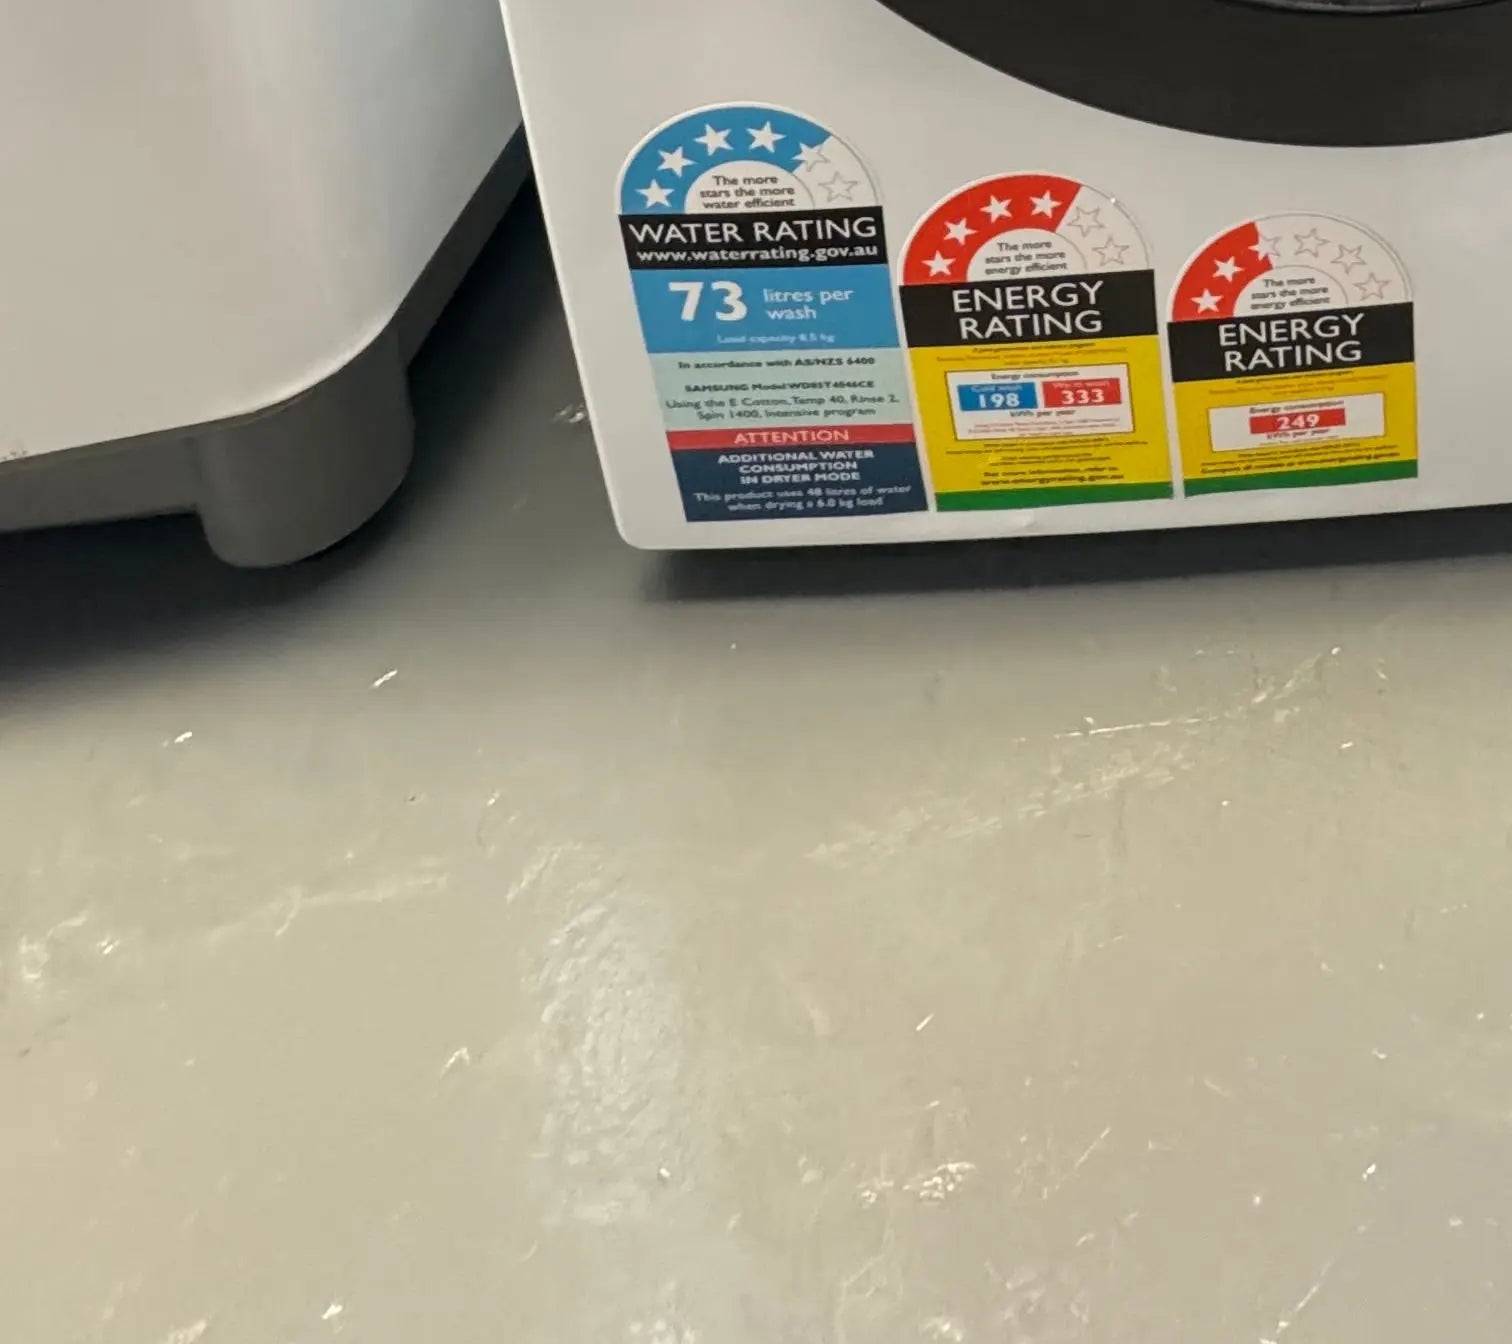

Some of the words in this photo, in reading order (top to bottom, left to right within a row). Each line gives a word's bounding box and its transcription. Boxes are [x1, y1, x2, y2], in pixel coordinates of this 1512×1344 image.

[713, 175, 740, 185] The
[743, 175, 778, 185] more
[700, 188, 730, 198] stars
[735, 187, 756, 197] the
[759, 186, 795, 196] more
[703, 199, 740, 210] water
[744, 197, 795, 209] efficient
[628, 223, 743, 244] WATER
[754, 216, 877, 242] RATING
[636, 244, 878, 262] www.waterrating.gov.au
[997, 242, 1020, 252] The
[1022, 241, 1052, 250] more
[985, 254, 1011, 264] stars
[1014, 253, 1033, 262] the
[1035, 251, 1066, 261] more
[985, 265, 1022, 276] energy
[1025, 261, 1068, 273] efficient
[1263, 278, 1285, 287] The
[1287, 276, 1315, 286] more
[763, 288, 813, 303] litres
[820, 289, 854, 305] per
[952, 280, 1104, 313] ENERGY
[1251, 290, 1277, 300] stars
[1279, 288, 1297, 297] the
[1299, 286, 1328, 295] more
[668, 280, 748, 322] 73
[1251, 301, 1287, 311] energy
[765, 306, 816, 320] wash
[959, 310, 1103, 340] RATING
[1218, 313, 1365, 347] ENERGY
[766, 359, 793, 367] with
[1224, 340, 1362, 372] RATING
[685, 383, 748, 393] SAMSUNG
[666, 399, 701, 410] Using
[705, 399, 725, 408] the
[729, 398, 737, 407] E
[793, 396, 825, 406] Temp
[978, 393, 1020, 409] 198
[1061, 389, 1105, 405] 333
[697, 412, 724, 422] Spin
[823, 407, 876, 418] program
[1277, 414, 1320, 430] 249
[734, 429, 849, 445] ATTENTION
[717, 452, 817, 464] ADDITIONAL
[819, 449, 874, 460] WATER
[739, 461, 858, 473] CONSUMPTION
[740, 476, 759, 485] IN
[762, 474, 811, 484] DRYER
[814, 472, 861, 482] MODE
[725, 490, 775, 502] product
[860, 486, 873, 496] of
[877, 485, 911, 494] water
[728, 502, 761, 512] when
[765, 500, 804, 511] drying
[839, 497, 854, 509] kg
[857, 496, 882, 507] load
